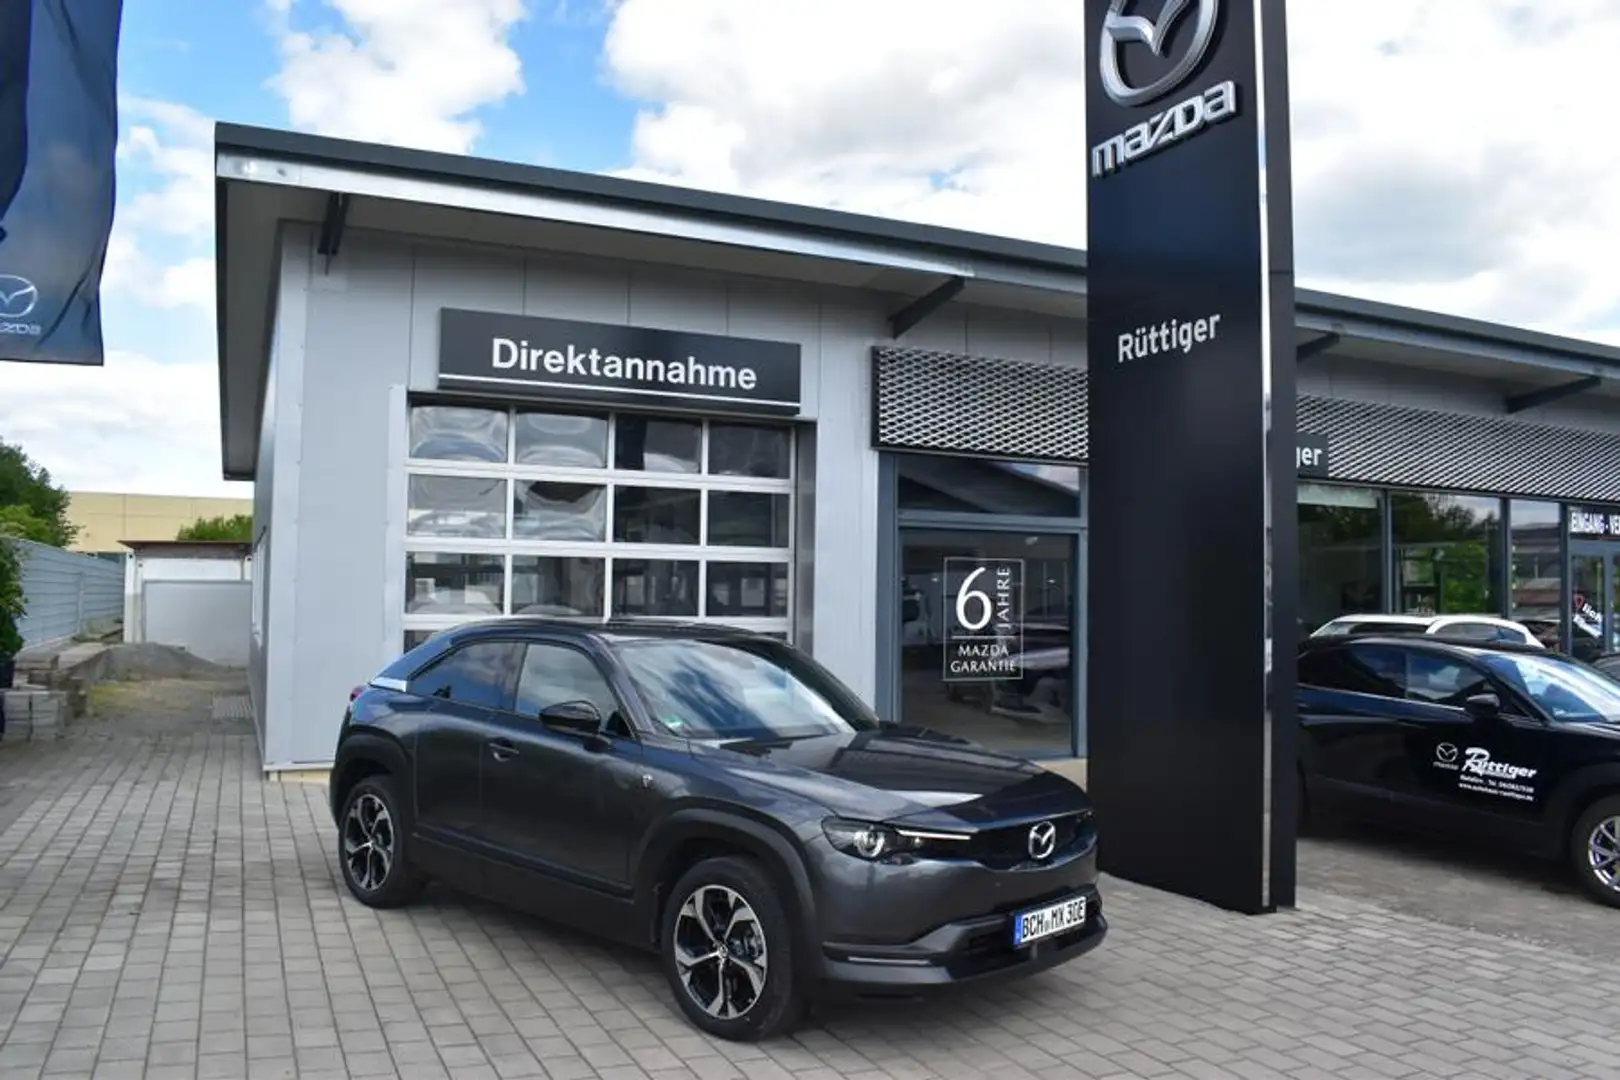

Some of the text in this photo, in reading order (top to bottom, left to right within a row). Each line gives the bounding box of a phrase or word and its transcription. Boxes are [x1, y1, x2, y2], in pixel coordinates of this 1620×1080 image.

[491, 337, 758, 390] Direktannahme
[1117, 313, 1222, 364] Rüttiger
[1609, 514, 1620, 535] VE
[955, 566, 992, 630] 6
[996, 567, 1011, 629] JAHRE
[950, 660, 1017, 673] GARANTIE
[958, 644, 1009, 657] MAZDA
